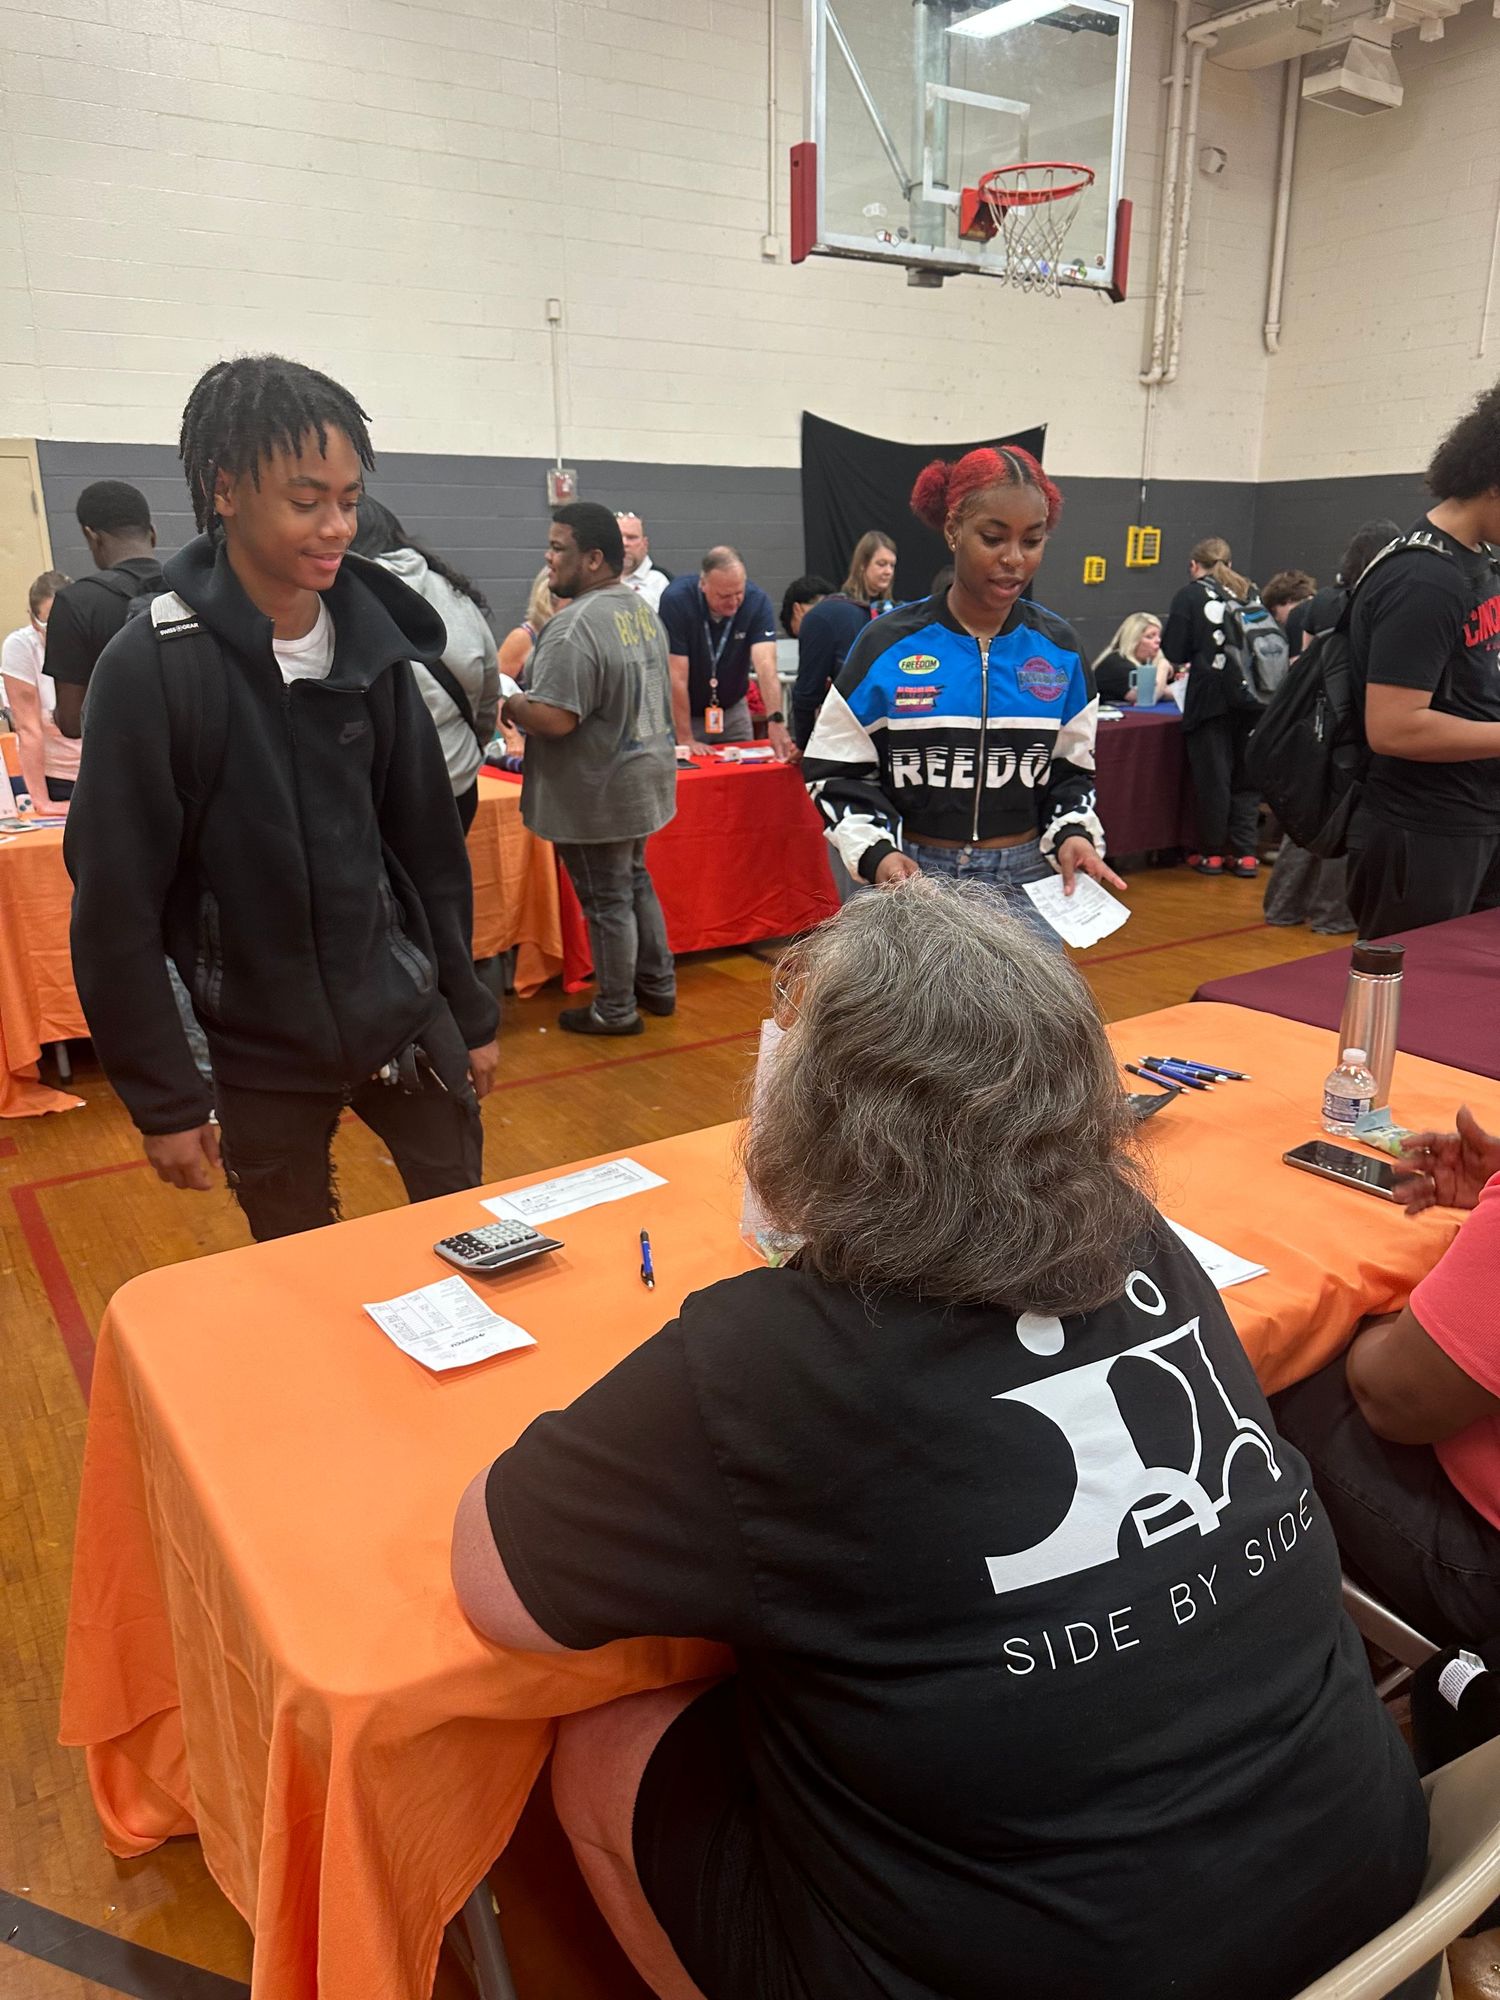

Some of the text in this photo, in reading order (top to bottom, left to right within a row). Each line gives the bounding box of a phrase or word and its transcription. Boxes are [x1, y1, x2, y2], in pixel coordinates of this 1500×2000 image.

[901, 659, 938, 670] FREEDOM
[888, 742, 1052, 789] REEDO
[1002, 1487, 1314, 1675] SIDE BY SIDE
